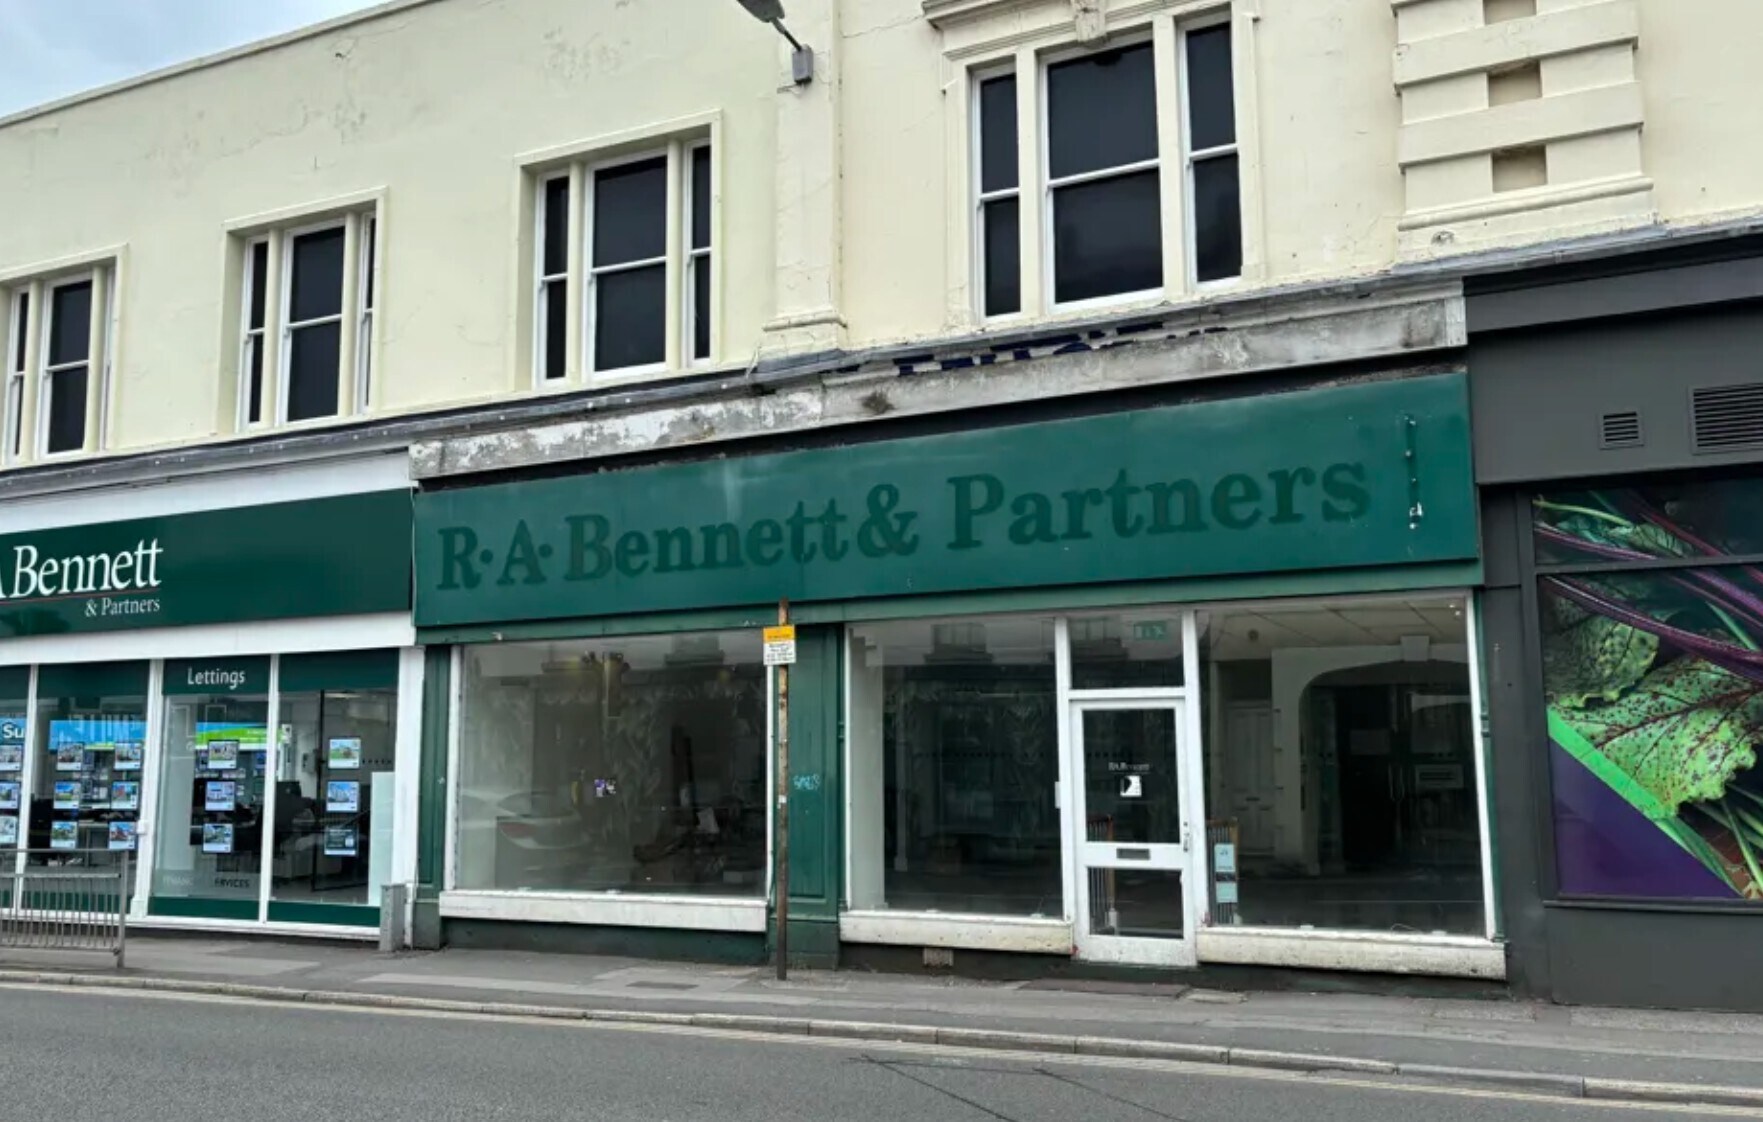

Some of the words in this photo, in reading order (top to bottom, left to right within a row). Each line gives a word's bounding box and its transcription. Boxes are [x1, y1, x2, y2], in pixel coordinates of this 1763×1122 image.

[564, 498, 849, 582] Bennett
[857, 483, 920, 558] &
[946, 460, 1372, 550] Partners
[9, 537, 164, 598] Bennett
[84, 599, 98, 617] &
[101, 597, 161, 615] Partners
[187, 667, 246, 690] Lettings
